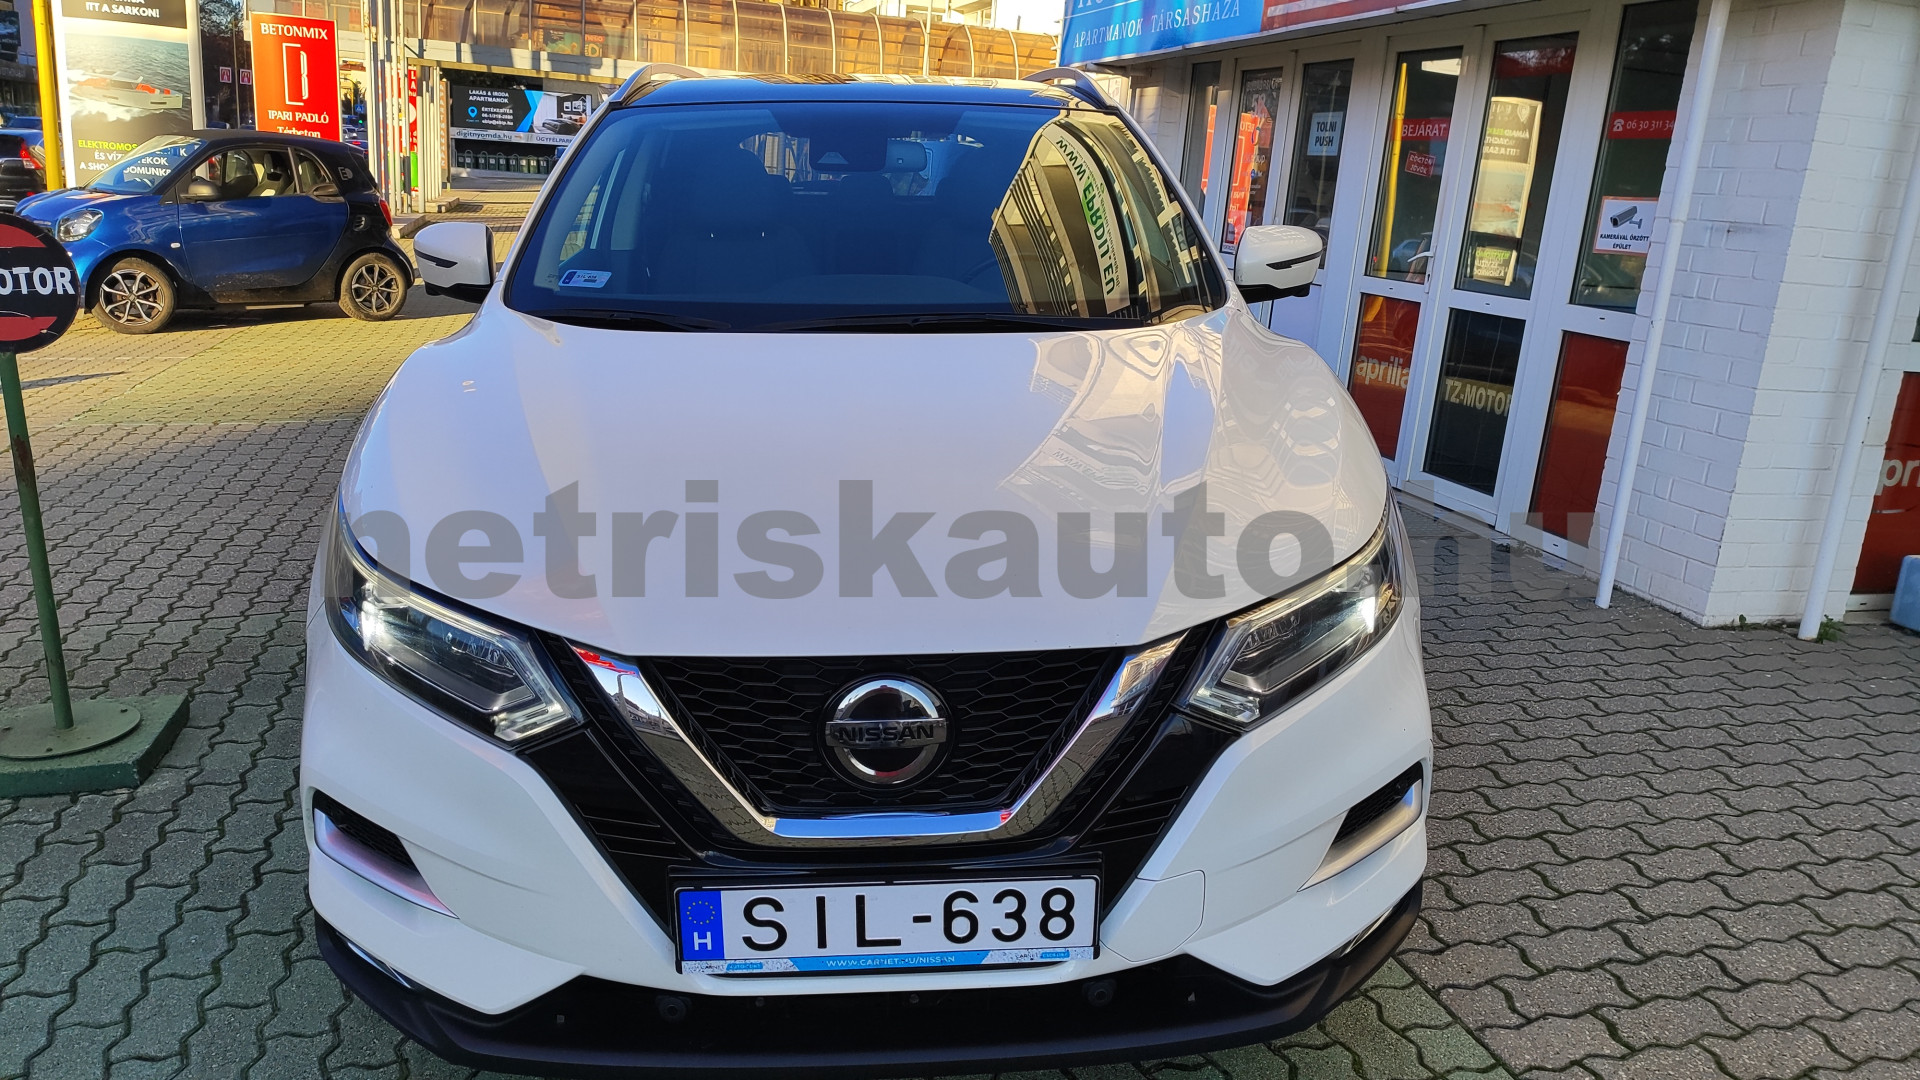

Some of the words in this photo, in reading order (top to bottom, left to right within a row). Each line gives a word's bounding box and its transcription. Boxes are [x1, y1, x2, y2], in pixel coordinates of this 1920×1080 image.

[85, 2, 99, 11] ITT
[102, 5, 110, 13] A
[111, 5, 160, 18] SARKON!
[260, 23, 328, 40] BETONMIX
[1073, 18, 1144, 49] APARTMANOK
[268, 110, 292, 121] IPARI
[295, 112, 329, 124] PADLÓ
[1316, 121, 1337, 132] TOLNI
[1402, 122, 1446, 137] BEJÁRAT
[1626, 120, 1636, 129] 06
[1639, 121, 1649, 131] 30
[1650, 120, 1662, 131] 311
[456, 130, 513, 141] digitnyomda.hu
[1315, 136, 1334, 146] PUSH
[94, 149, 105, 160] ÉS
[1600, 233, 1628, 241] KAMERÁVAL
[1612, 242, 1632, 250] ÉPÜLET
[838, 724, 934, 742] NISSAN
[741, 888, 1076, 952] SIL-638
[693, 932, 713, 951] H
